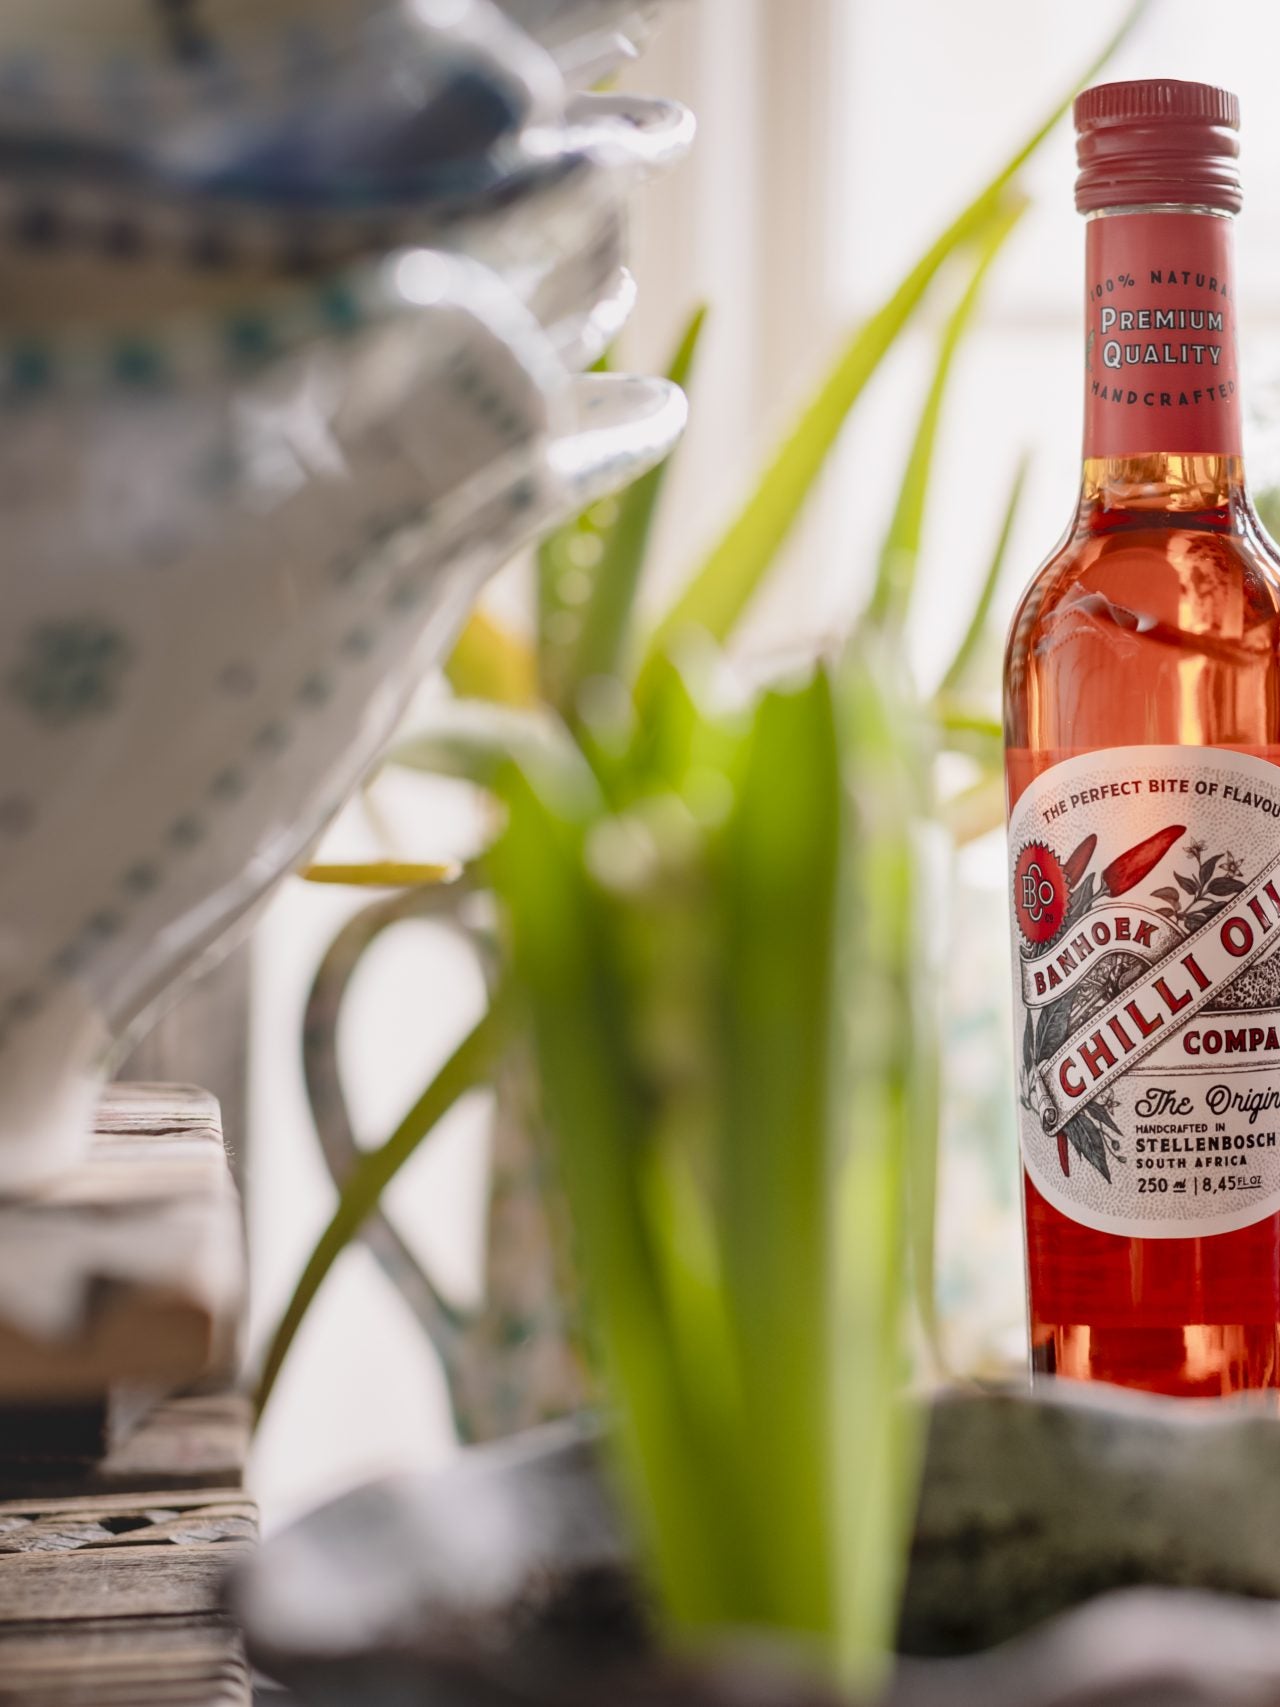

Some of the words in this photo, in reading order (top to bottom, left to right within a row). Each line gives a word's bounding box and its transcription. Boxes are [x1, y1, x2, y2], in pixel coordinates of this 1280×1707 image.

[1091, 380, 1235, 407] HANDCRAFTED
[1042, 803, 1068, 825] THE
[1071, 780, 1142, 809] PERFECT
[1149, 779, 1189, 793] BITE
[1195, 780, 1218, 796] OF
[1034, 917, 1159, 996] BANHOEK
[1058, 952, 1213, 1098] CHILLI
[1134, 1087, 1194, 1118] The
[1135, 1123, 1208, 1134] HANDCRAFTED
[1214, 1122, 1226, 1132] IN
[1135, 1132, 1277, 1153] STELLENBOSCH
[1136, 1158, 1187, 1169] SOUTH
[1194, 1155, 1248, 1168] AFRICA
[1137, 1177, 1169, 1194] 250
